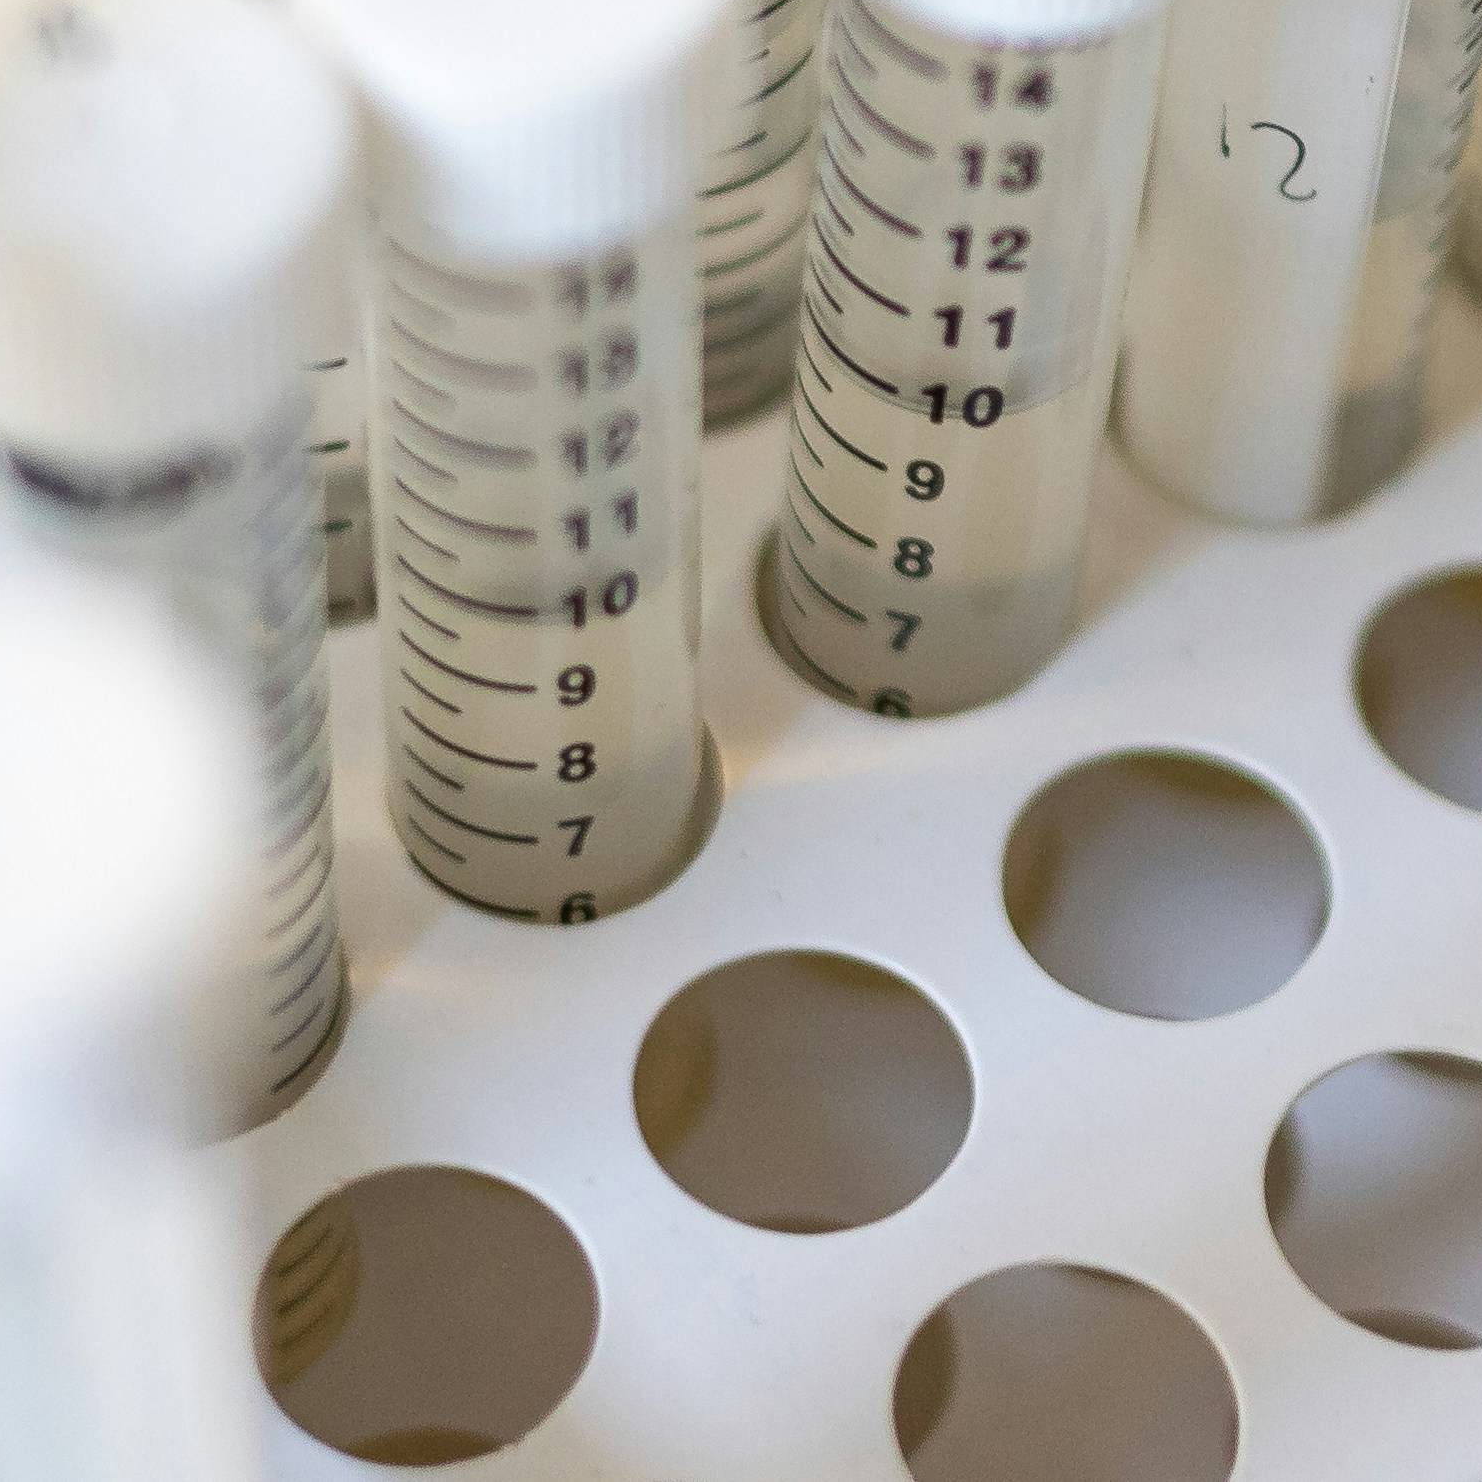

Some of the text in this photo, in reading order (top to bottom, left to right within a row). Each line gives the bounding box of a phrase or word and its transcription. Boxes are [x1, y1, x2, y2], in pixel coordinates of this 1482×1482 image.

[971, 62, 1056, 111] 14
[959, 142, 1044, 192] 13
[944, 223, 1031, 273] 12
[932, 304, 1017, 350] 11
[921, 382, 1005, 429] 10
[905, 458, 945, 502] 9
[564, 486, 639, 550] 11
[892, 536, 935, 580] 8
[564, 569, 638, 630] 10
[885, 609, 922, 652] 7
[556, 664, 597, 707] 9
[556, 742, 597, 784] 8
[556, 816, 594, 858] 7
